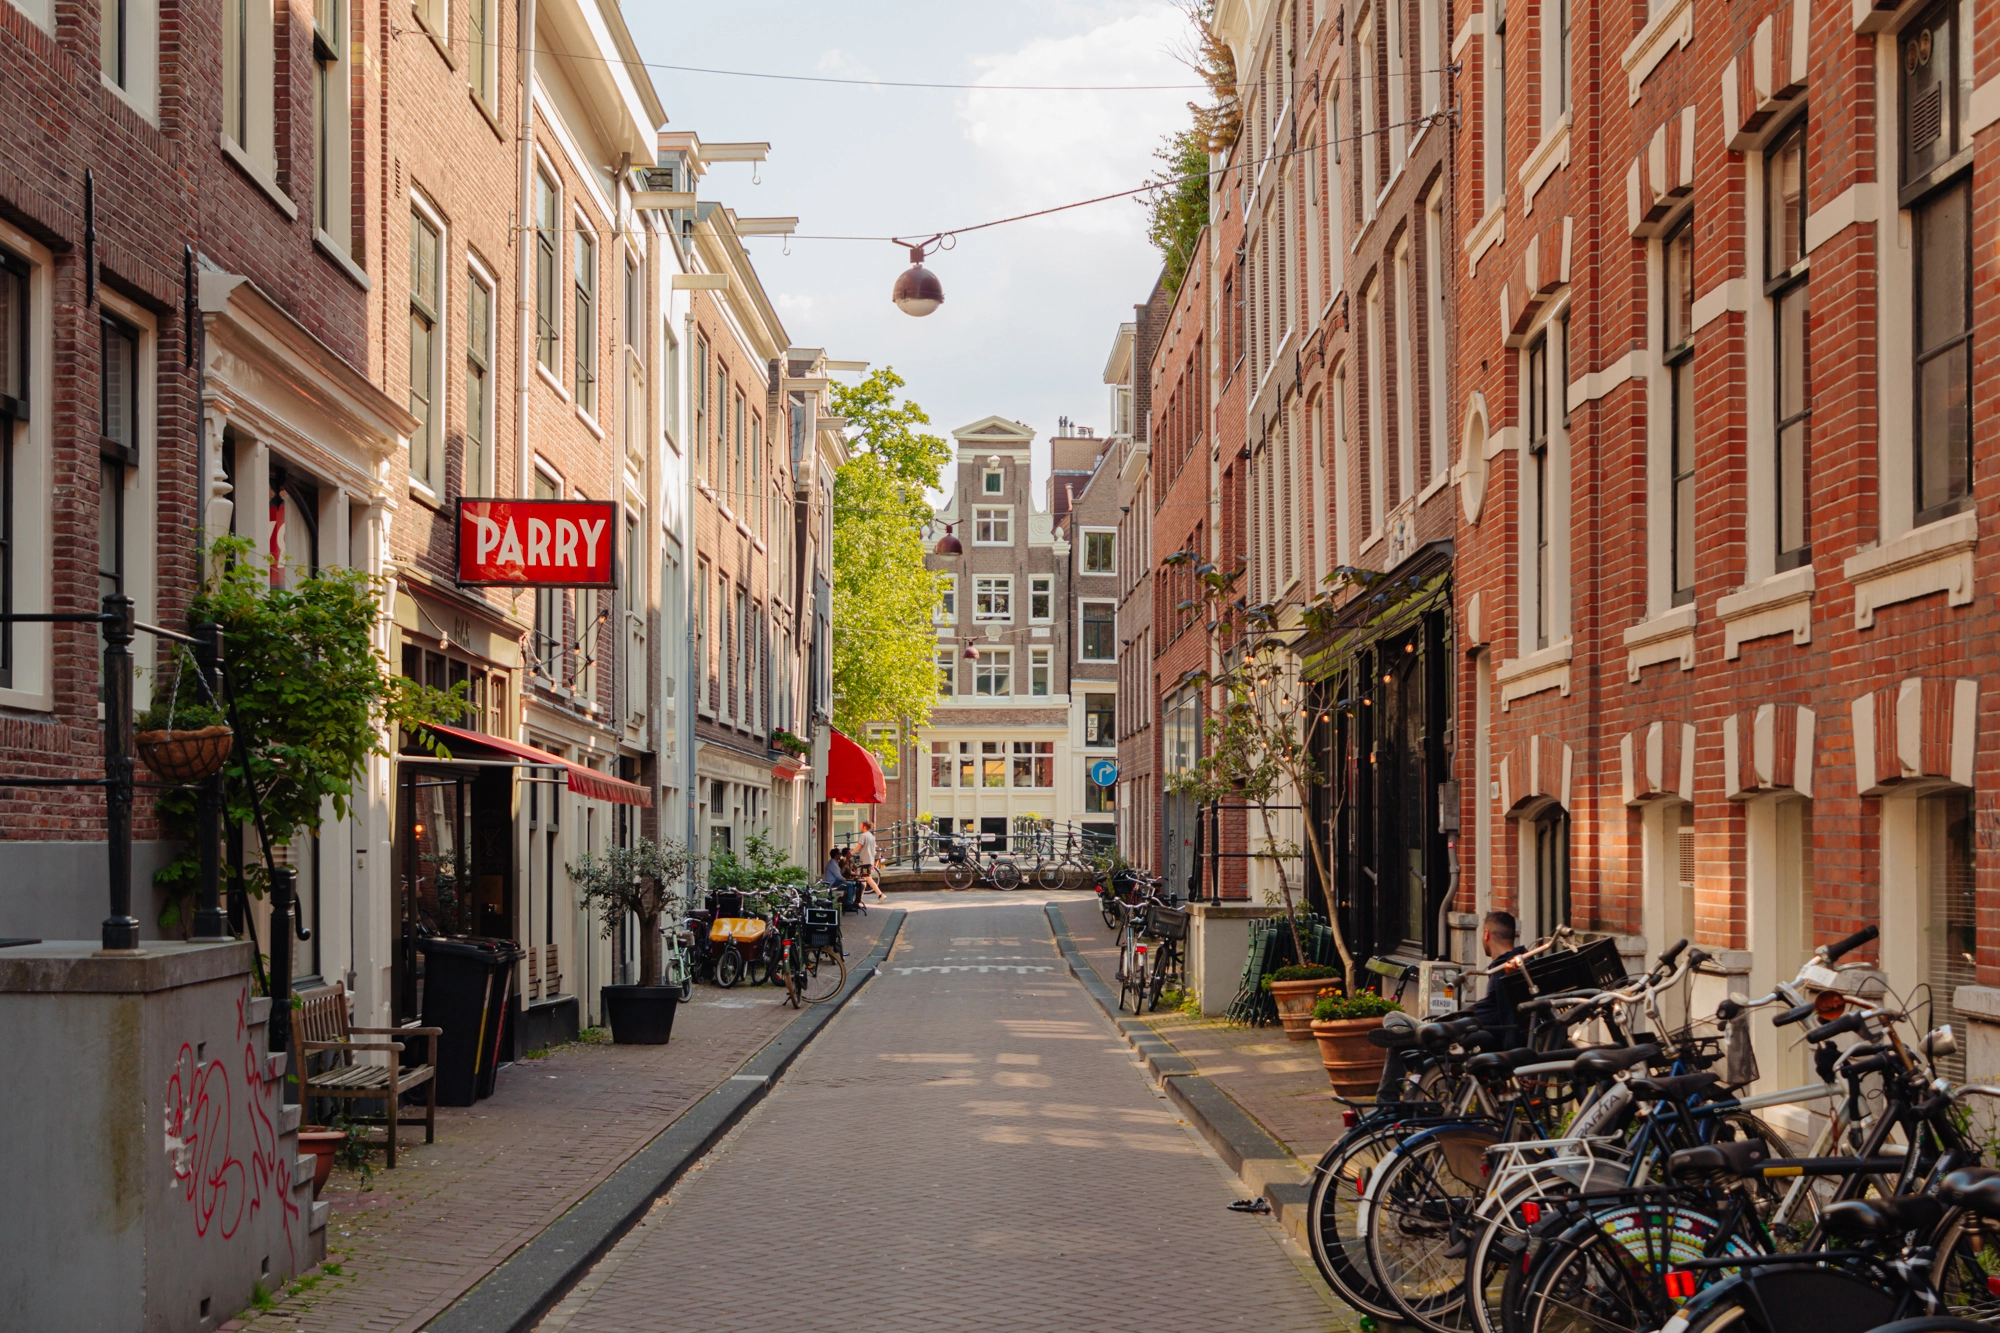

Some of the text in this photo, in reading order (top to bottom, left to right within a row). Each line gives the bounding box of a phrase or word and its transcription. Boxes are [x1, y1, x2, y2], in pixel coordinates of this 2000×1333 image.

[476, 516, 606, 568] PARRY
[454, 616, 471, 650] BAR
[1573, 1094, 1621, 1142] PARTA
